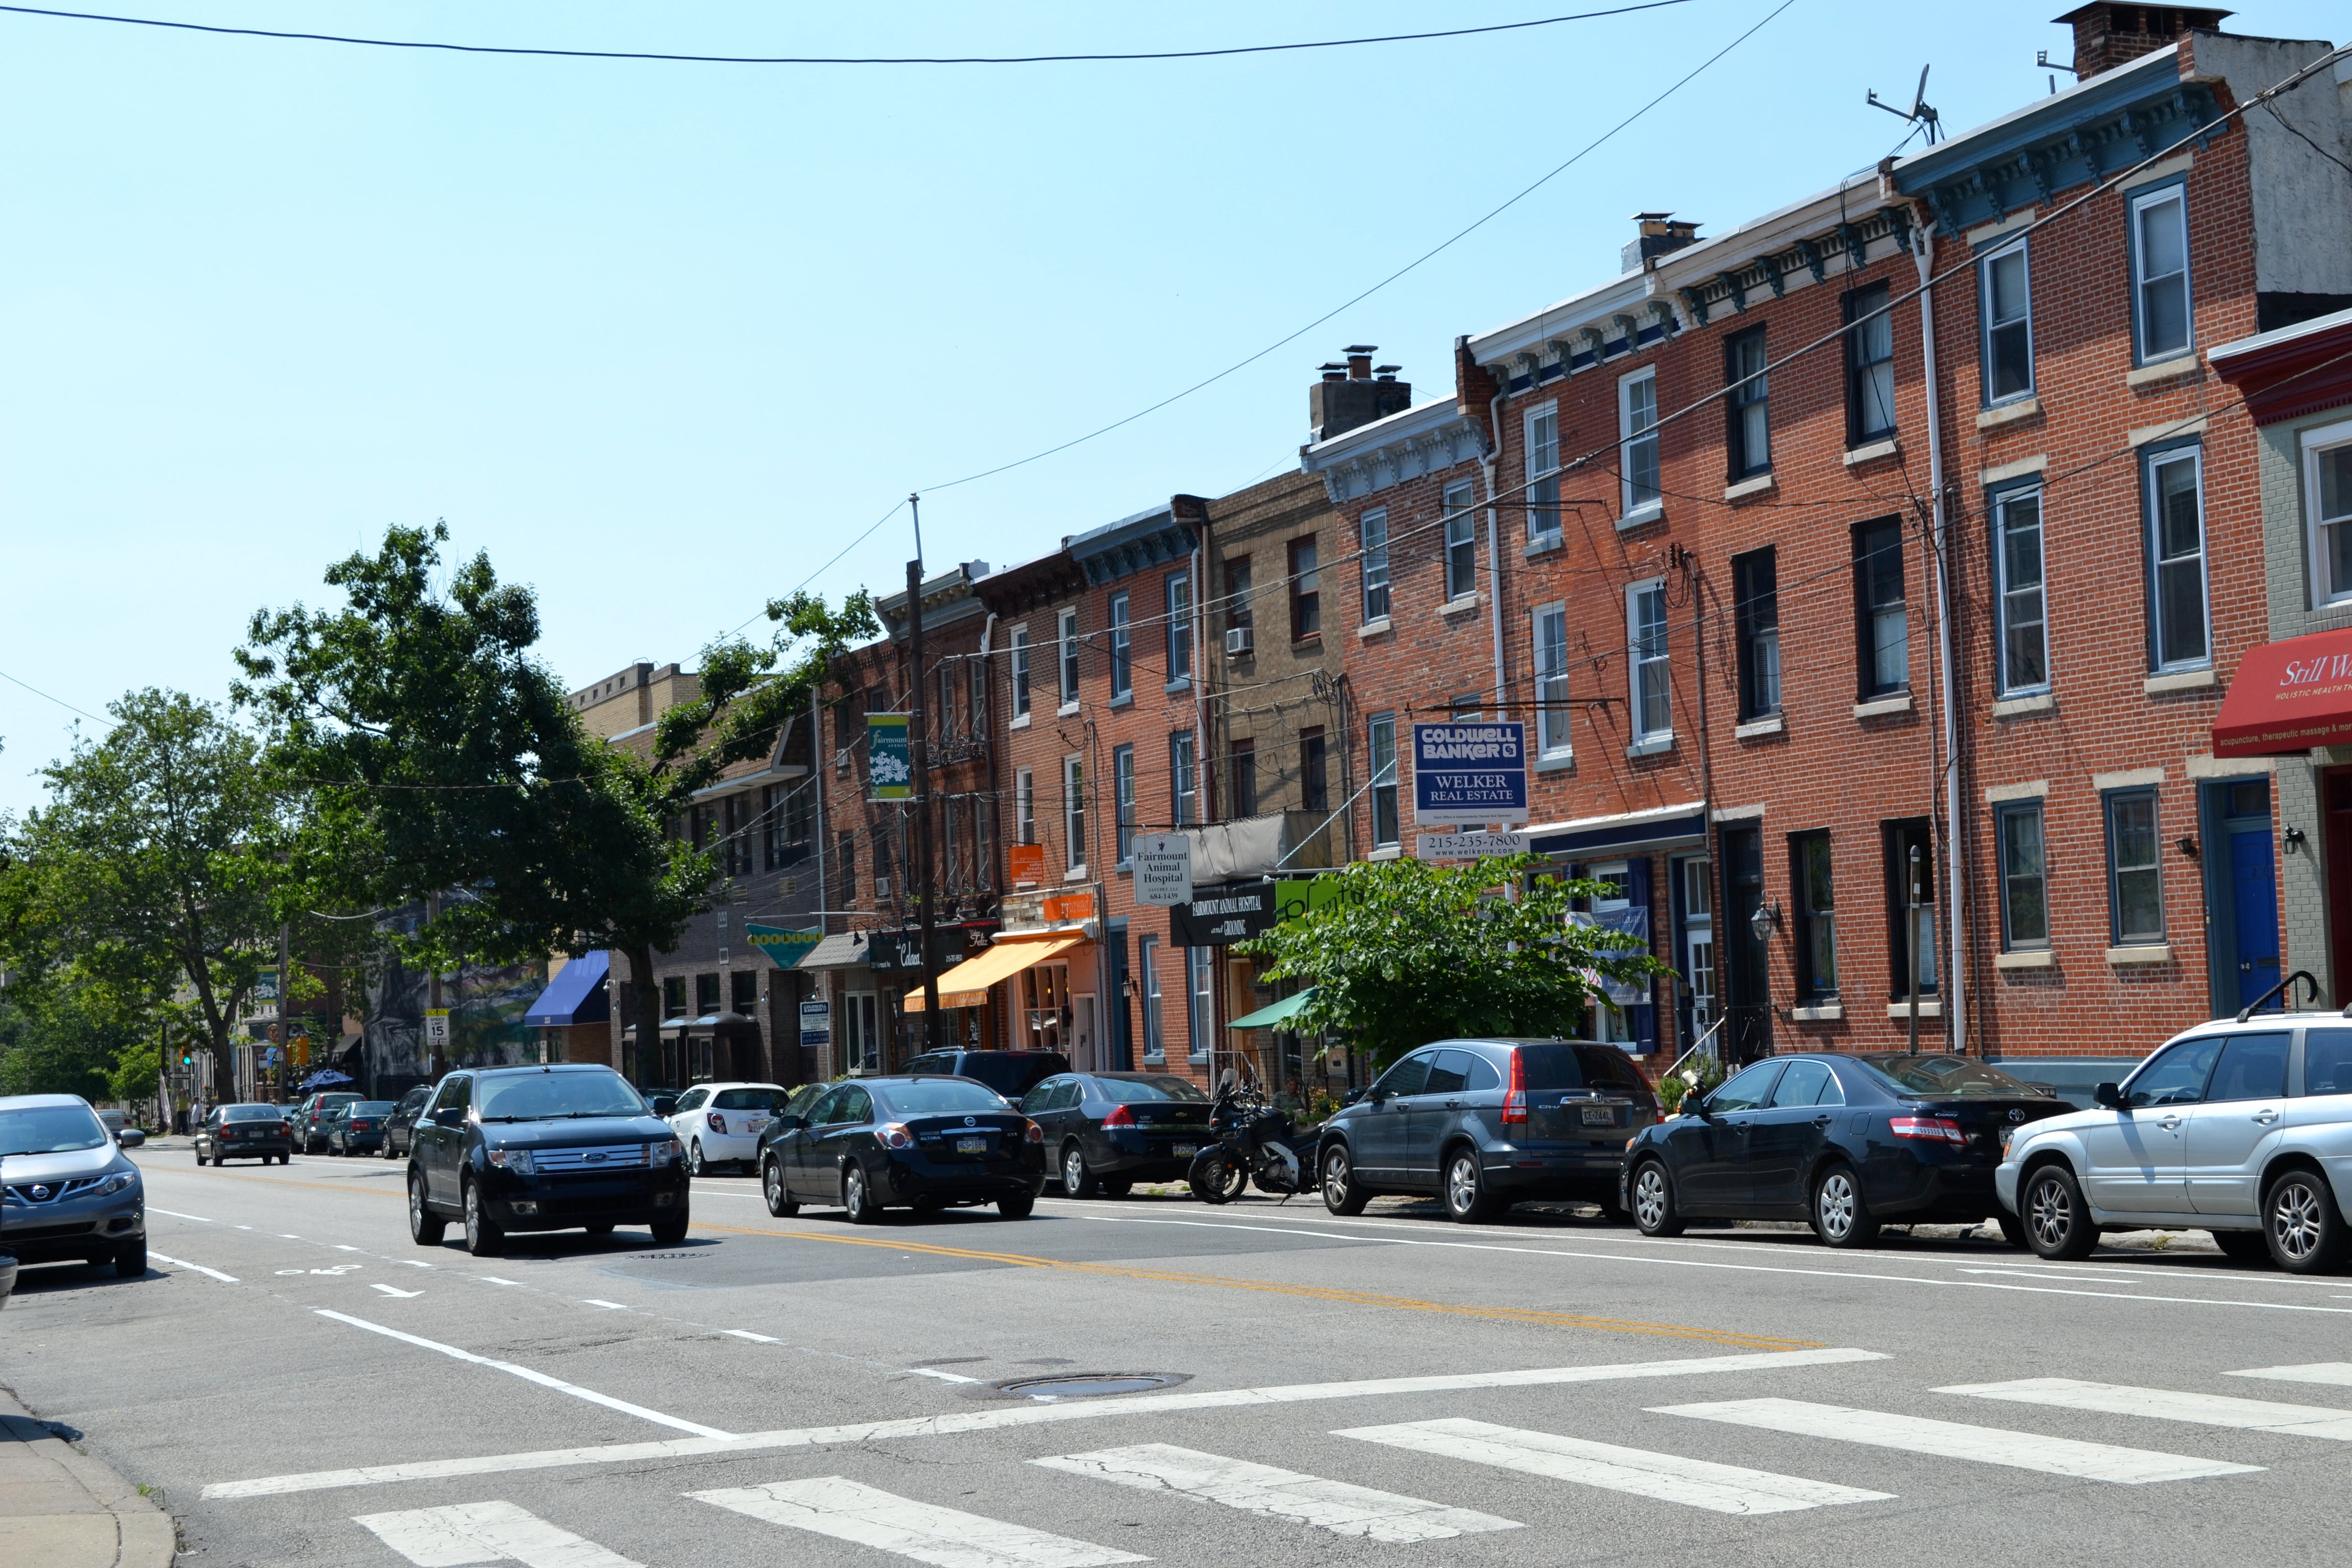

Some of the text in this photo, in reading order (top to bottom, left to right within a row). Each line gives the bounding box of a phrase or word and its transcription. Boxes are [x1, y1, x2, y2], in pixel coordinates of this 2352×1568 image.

[2280, 655, 2328, 686] Still
[2275, 689, 2311, 700] HOLISTIC
[2312, 685, 2342, 696] HEALTH
[870, 729, 907, 749] fairmount
[1422, 728, 1517, 743] COLDWELL
[2220, 736, 2261, 747] acupuncture,
[2262, 729, 2298, 742] therapeutic
[2300, 725, 2330, 737] massage
[1424, 743, 1500, 761] BANKER
[1435, 775, 1507, 789] WELKER
[1430, 790, 1513, 801] REAL ESTATE
[1429, 835, 1520, 848] 215-235-7800
[1138, 852, 1188, 861] Fairmount
[1435, 848, 1514, 856] www.welkerre.com
[1146, 862, 1180, 872] Animal
[1144, 873, 1183, 885] Hospital
[1192, 895, 1262, 916] FAIRMOUNT ANIMAL HOSPITAL
[1211, 924, 1223, 934] and
[1224, 919, 1246, 936] GROOMING
[751, 930, 820, 943] beehive
[969, 934, 988, 947] Feliz
[432, 1026, 444, 1036] 15
